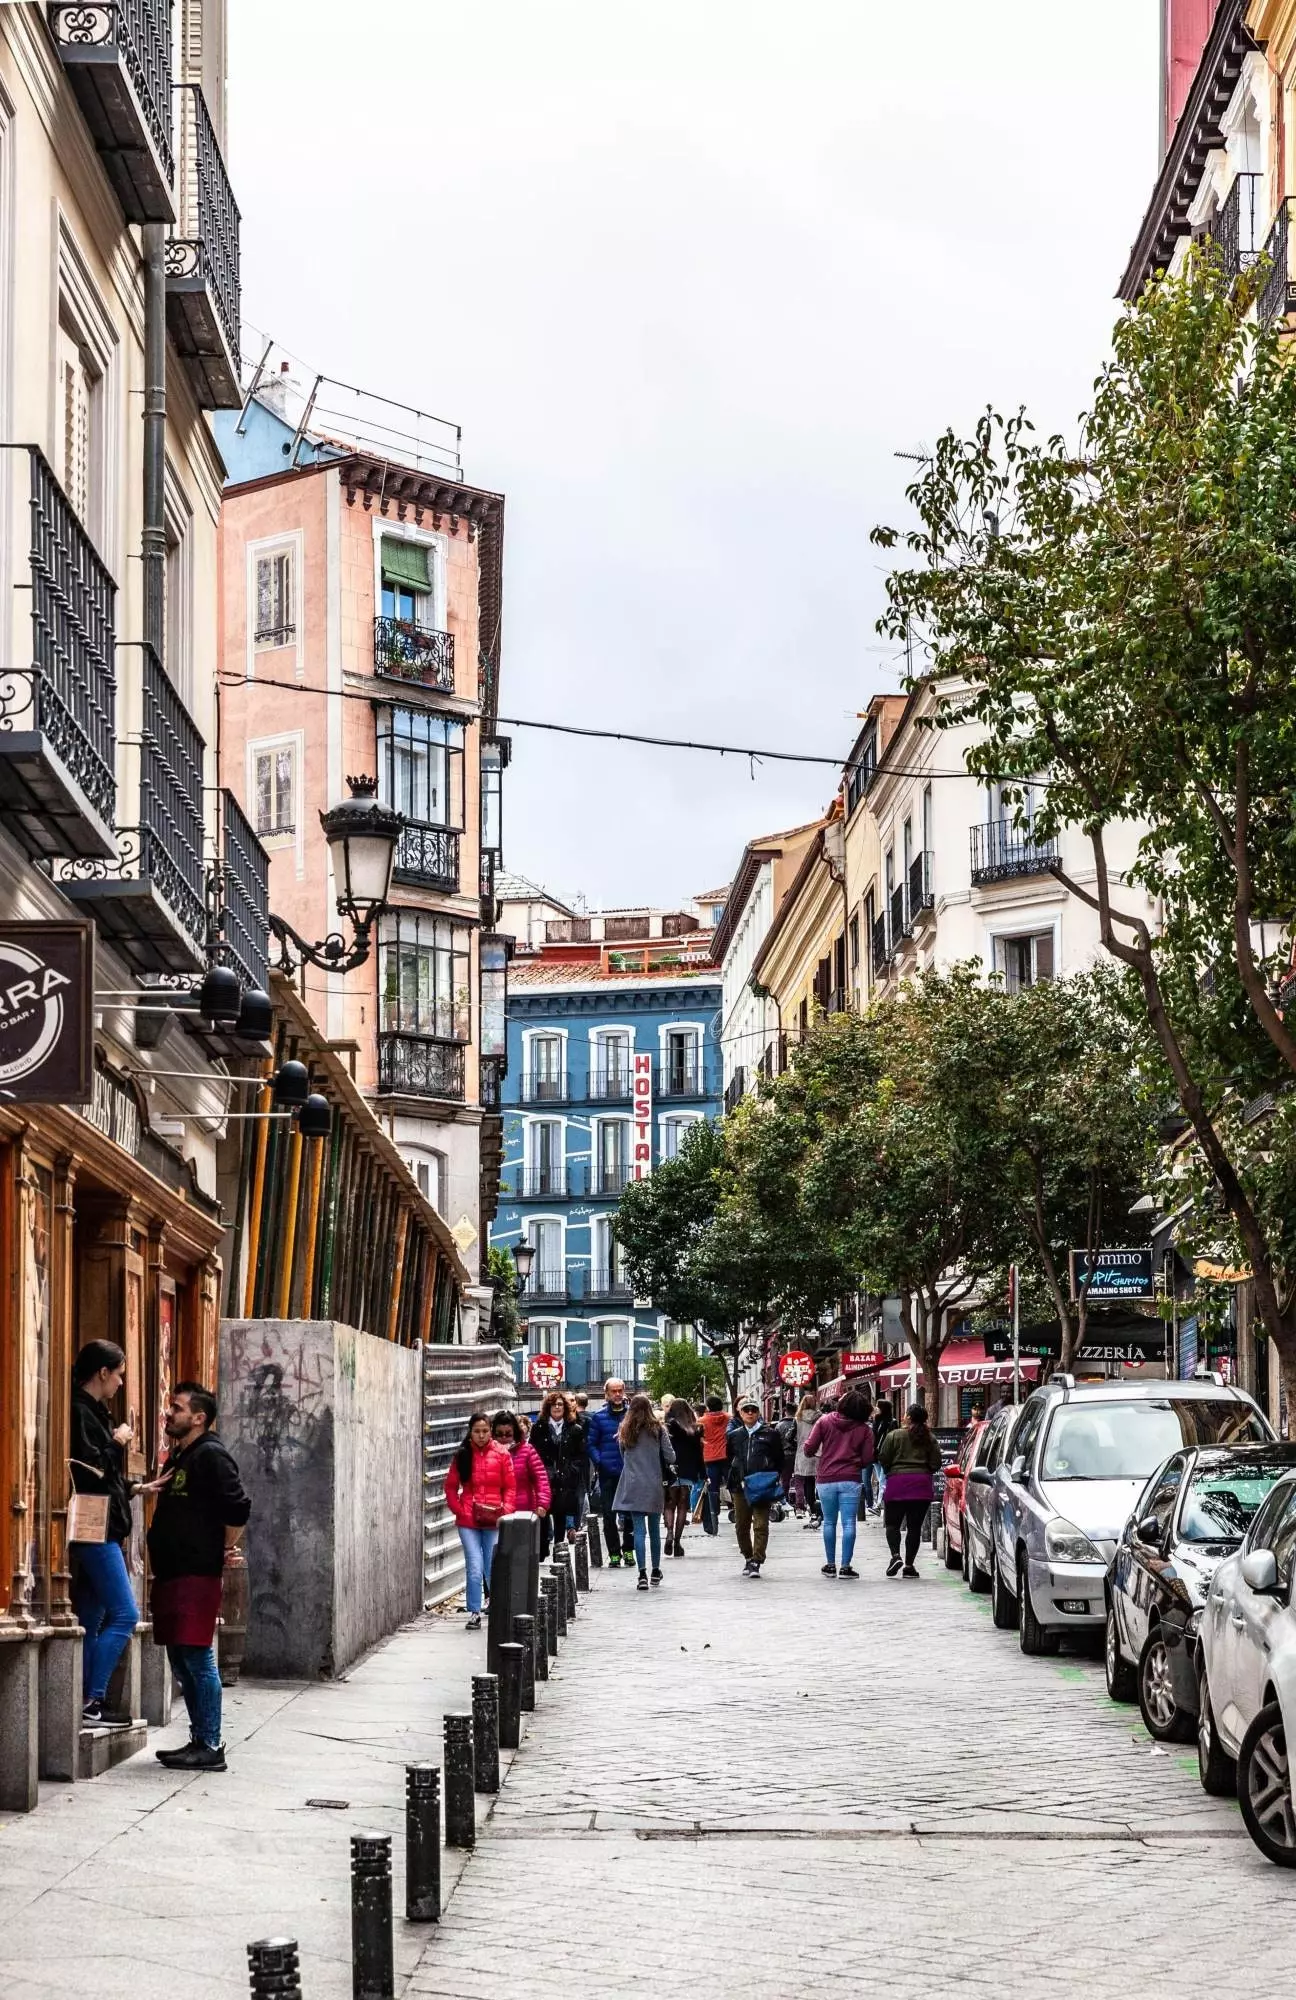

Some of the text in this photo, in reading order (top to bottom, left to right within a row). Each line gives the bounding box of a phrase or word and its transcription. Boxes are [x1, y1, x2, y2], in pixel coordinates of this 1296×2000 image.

[0, 968, 71, 1014] RA
[9, 1010, 30, 1025] BAR
[3, 1056, 32, 1075] MADRID
[635, 1055, 650, 1182] HOSTAL
[1086, 1286, 1142, 1295] AMAZING SHOTS
[993, 1343, 1007, 1351] EL
[1077, 1343, 1146, 1359] ZZERÍA
[891, 1375, 918, 1388] LA
